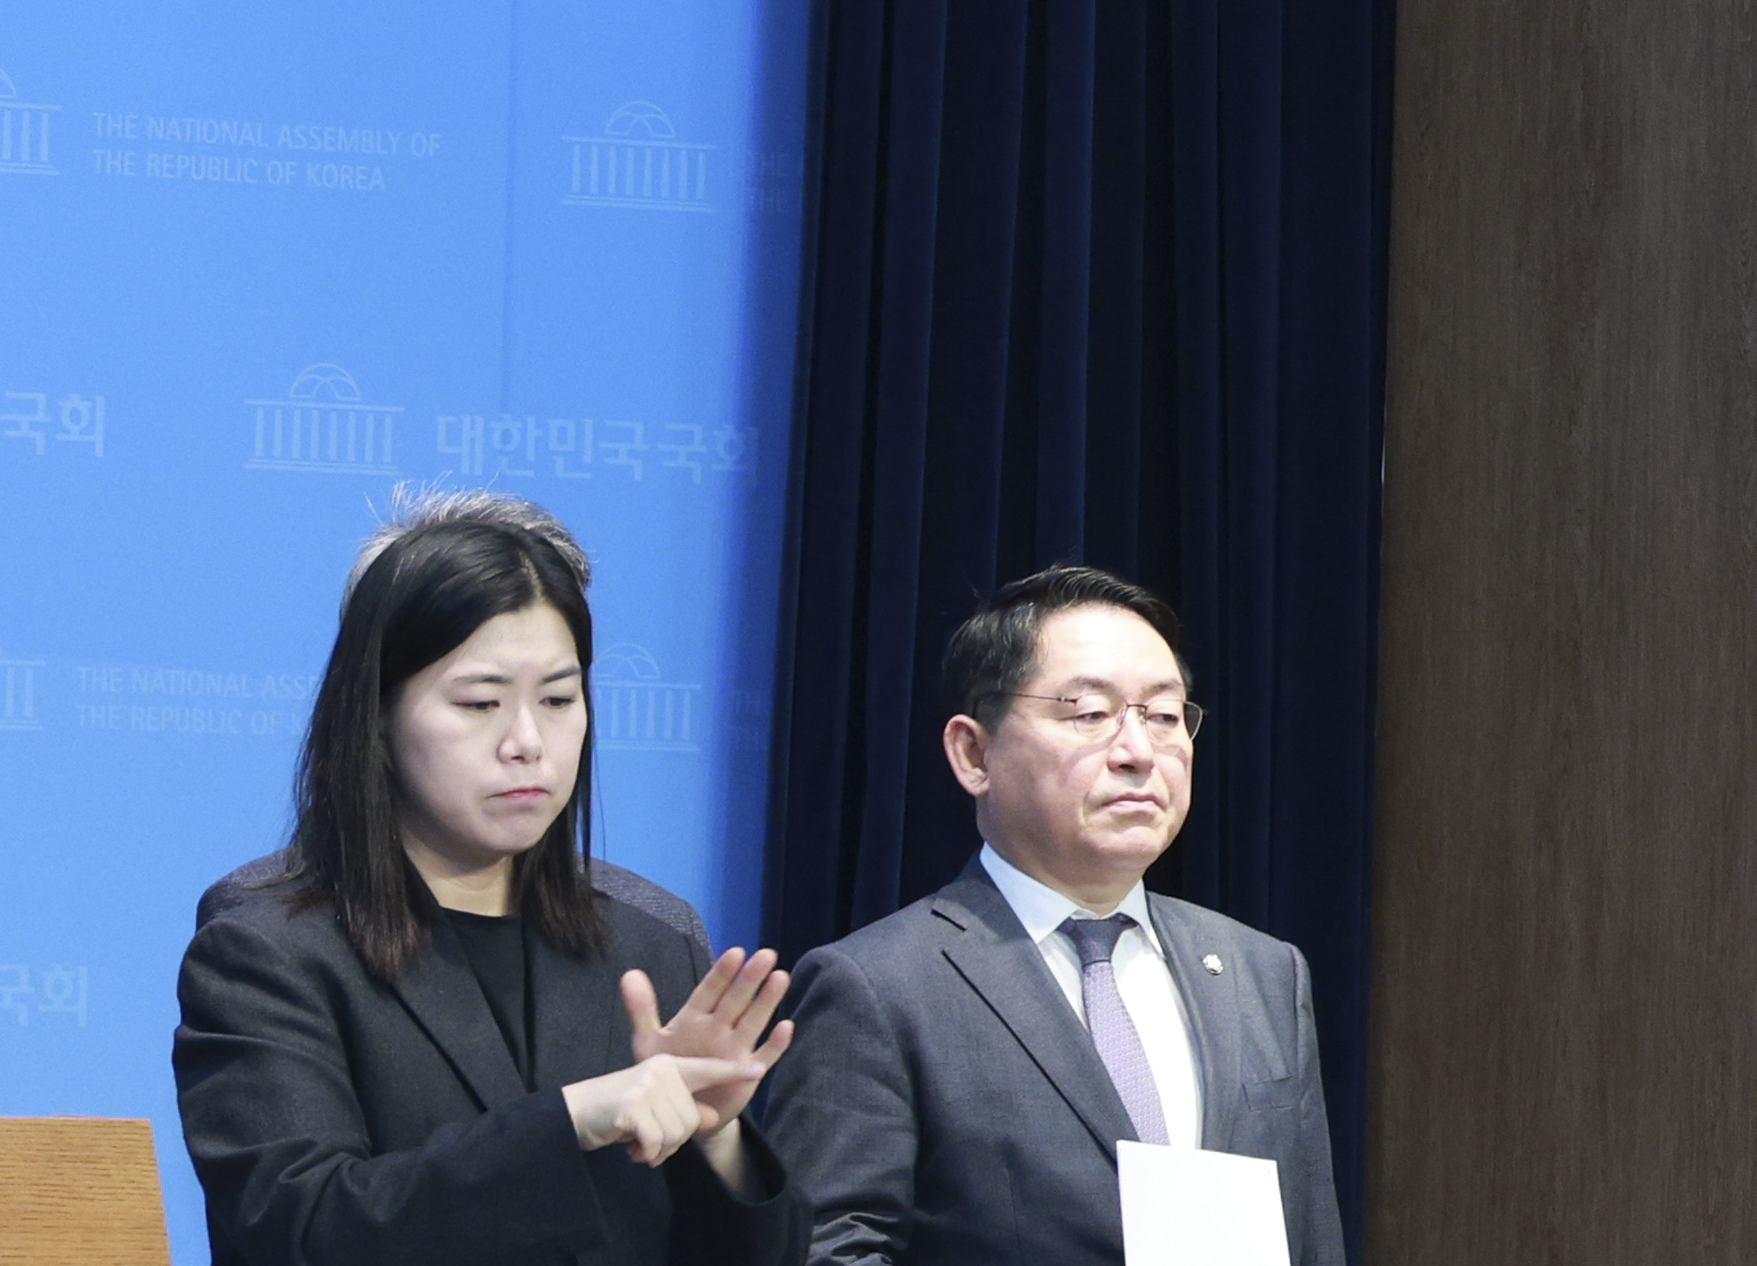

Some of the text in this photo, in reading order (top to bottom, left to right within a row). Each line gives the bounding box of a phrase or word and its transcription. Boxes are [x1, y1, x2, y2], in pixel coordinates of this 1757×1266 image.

[91, 110, 442, 159] THE NATIONAL ASSEMBLY OF
[91, 148, 387, 193] THE REPUBLIC OF KOREA
[435, 412, 760, 486] 대한민국국회
[75, 664, 123, 693] THE
[131, 666, 252, 698] NATIONAL
[75, 703, 122, 731] THE
[130, 705, 243, 735] REPUBLIC
[250, 709, 283, 737] OF
